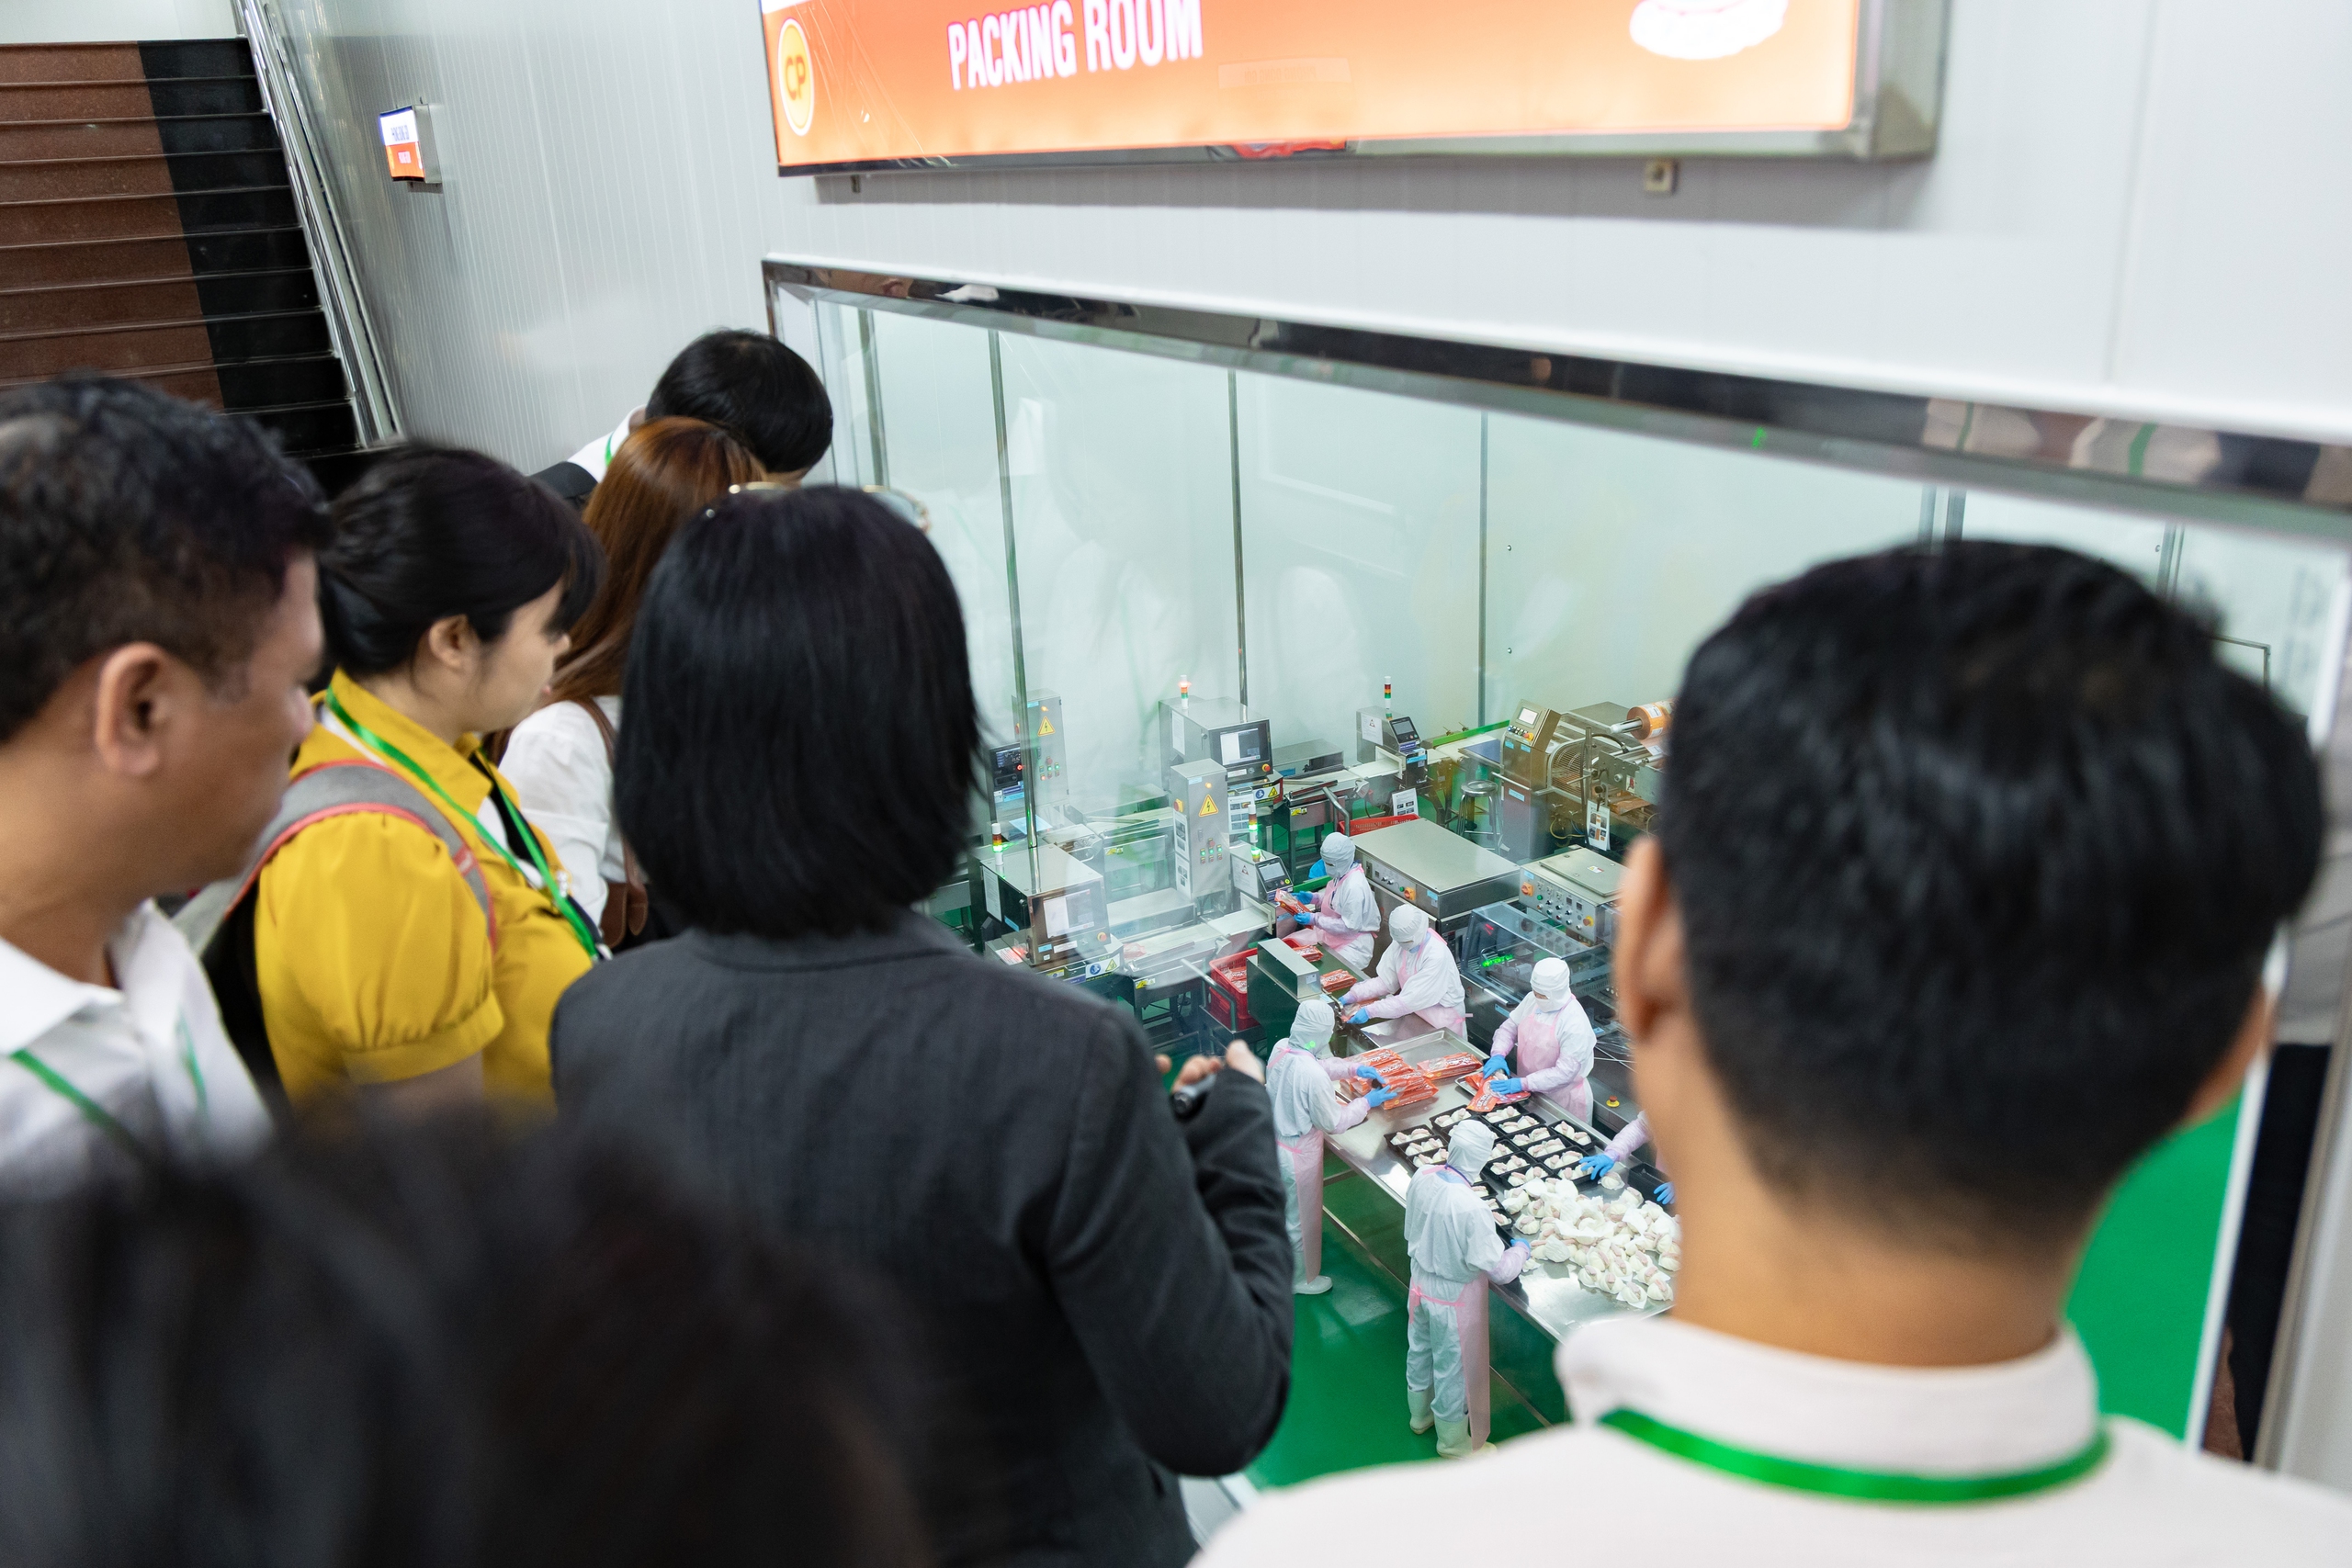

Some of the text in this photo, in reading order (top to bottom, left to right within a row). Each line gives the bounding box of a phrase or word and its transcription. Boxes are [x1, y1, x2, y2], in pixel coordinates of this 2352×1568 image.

[786, 54, 806, 100] CP
[947, 0, 1204, 90] PACKING ROOM
